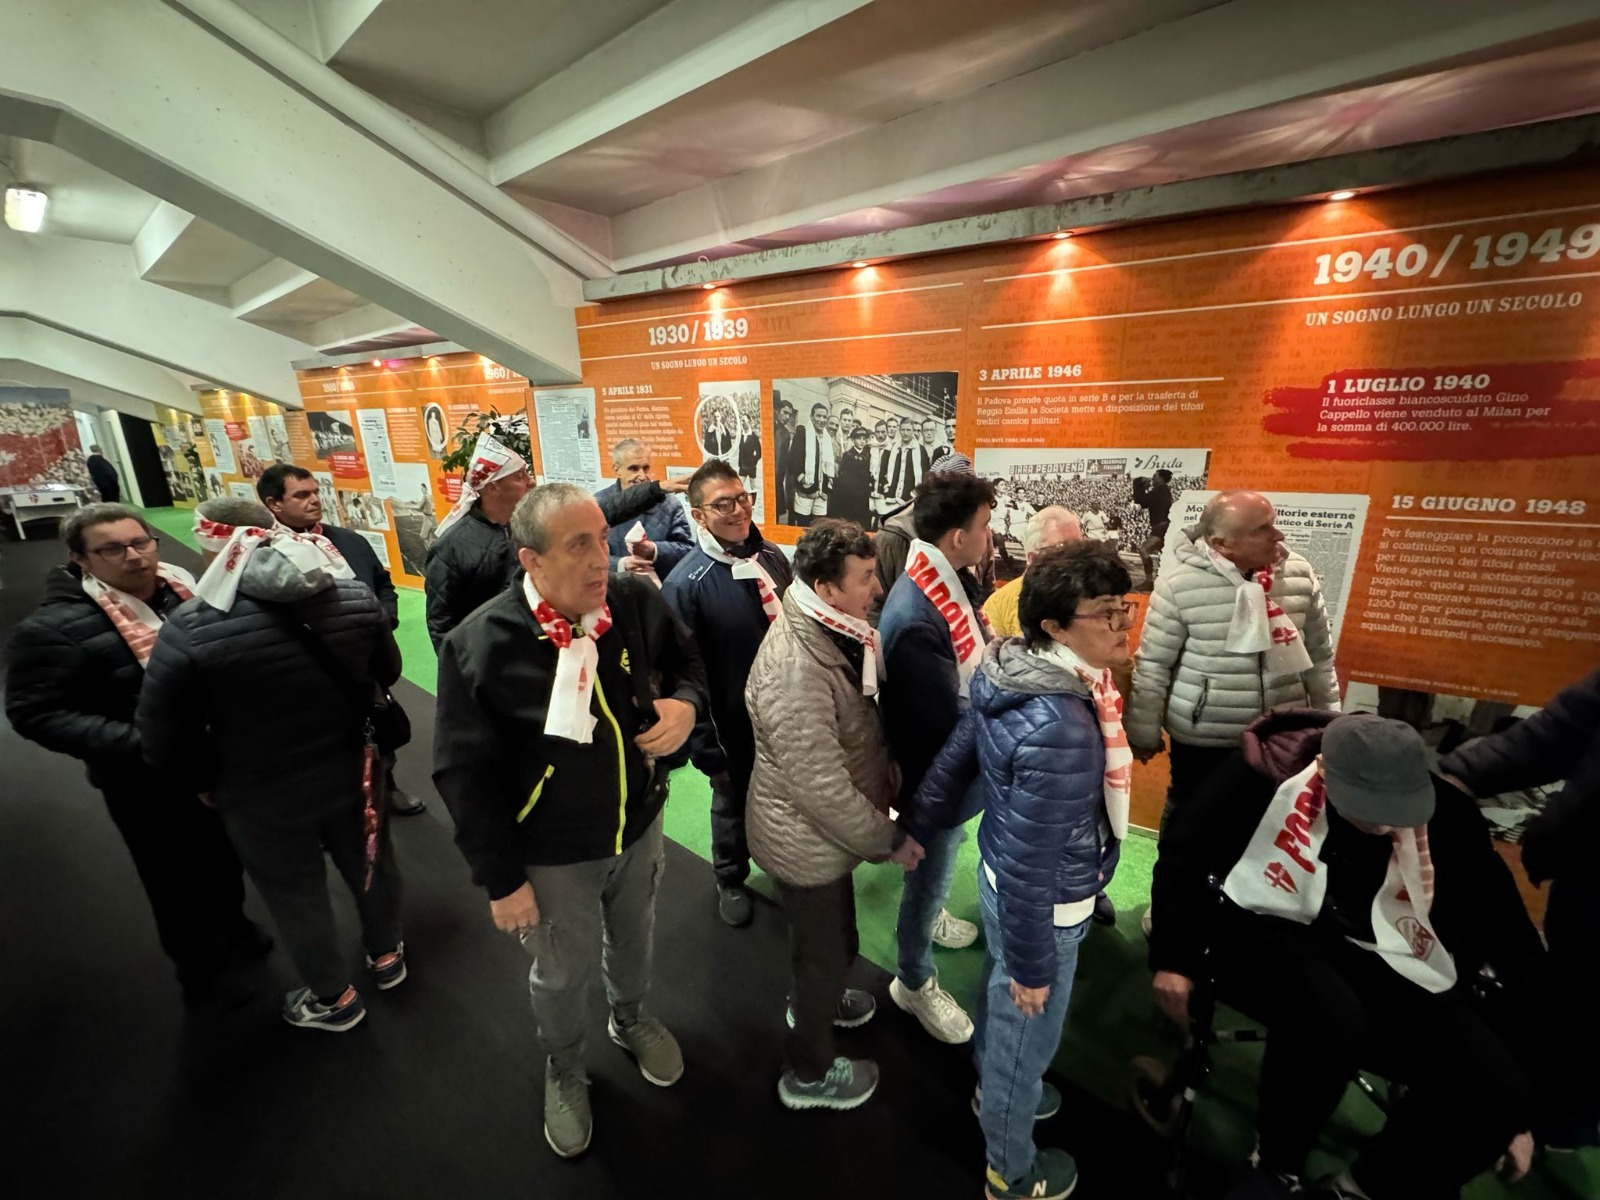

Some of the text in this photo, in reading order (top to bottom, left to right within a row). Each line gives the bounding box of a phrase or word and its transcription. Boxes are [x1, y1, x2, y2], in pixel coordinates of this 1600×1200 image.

[1306, 291, 1582, 326] UN SOGNO LUNGO UN SECOLO
[650, 355, 748, 370] UN SOGNO LUNGO UN SECOLO
[978, 364, 1082, 381] 3 APRILE 1946
[602, 385, 653, 396] 5 APRILE 1931
[1327, 374, 1490, 393] 1 LUGLIO 1940
[984, 396, 1011, 405] Padova
[1013, 396, 1041, 406] prende
[1043, 395, 1066, 405] quota
[1068, 394, 1077, 403] in
[1079, 393, 1099, 402] serie
[1102, 393, 1108, 401] B
[1119, 393, 1134, 402] per
[1136, 392, 1144, 400] la
[1147, 391, 1186, 400] trasferta
[1188, 390, 1199, 399] di
[1322, 392, 1529, 407] Il fuoriclasse biancoscudato Gino
[976, 408, 1002, 416] Reggio
[1004, 406, 1028, 415] Emilia
[1030, 406, 1038, 414] la
[1071, 405, 1095, 413] mette
[1105, 403, 1160, 414] disposizione
[1163, 402, 1178, 411] dei
[1181, 401, 1204, 411] tifosi
[1320, 406, 1551, 421] Cappello viene venduto al Milan per
[976, 416, 1061, 426] tredici camion militari.
[1317, 421, 1472, 432] la somma di 400.000 lire.
[1010, 462, 1085, 475] BIRRA PEDAVENA
[1391, 495, 1587, 515] 15 GIUGNO 1948
[1310, 511, 1356, 520] esterne
[1275, 519, 1302, 527] istico
[1303, 519, 1314, 527] di
[1316, 520, 1342, 529] Serie
[1344, 521, 1354, 529] A
[1381, 528, 1401, 538] Per
[1404, 528, 1473, 544] festeggiare
[1477, 532, 1489, 542] la
[1492, 533, 1574, 547] promozione
[1578, 536, 1593, 548] in
[1379, 541, 1389, 550] si
[1392, 541, 1456, 553] costituisce
[1460, 545, 1476, 555] un
[1480, 545, 1538, 558] comitato
[1376, 553, 1396, 563] per
[1399, 553, 1454, 566] iniziativa
[1458, 557, 1478, 567] dei
[1482, 558, 1514, 570] tifosi
[1374, 563, 1575, 587] Viene aperta una sottoscrizione
[1368, 586, 1388, 597] lire
[1390, 589, 1411, 599] per
[1413, 591, 1471, 603] comprare
[1475, 597, 1536, 610] medaglie
[1430, 580, 1465, 591] quota
[1468, 583, 1517, 595] minima
[1521, 587, 1538, 597] da
[1543, 588, 1562, 598] 50
[1566, 591, 1575, 600] a
[907, 551, 977, 665] PADOVA
[1367, 598, 1396, 608] 1200
[1398, 601, 1418, 611] lire
[1421, 604, 1442, 614] per
[1445, 607, 1480, 617] poter
[1363, 611, 1393, 620] cena
[1394, 613, 1416, 623] che
[1418, 615, 1430, 624] la
[1360, 621, 1407, 634] squadra
[1409, 626, 1418, 635] il
[1031, 1179, 1048, 1197] N
